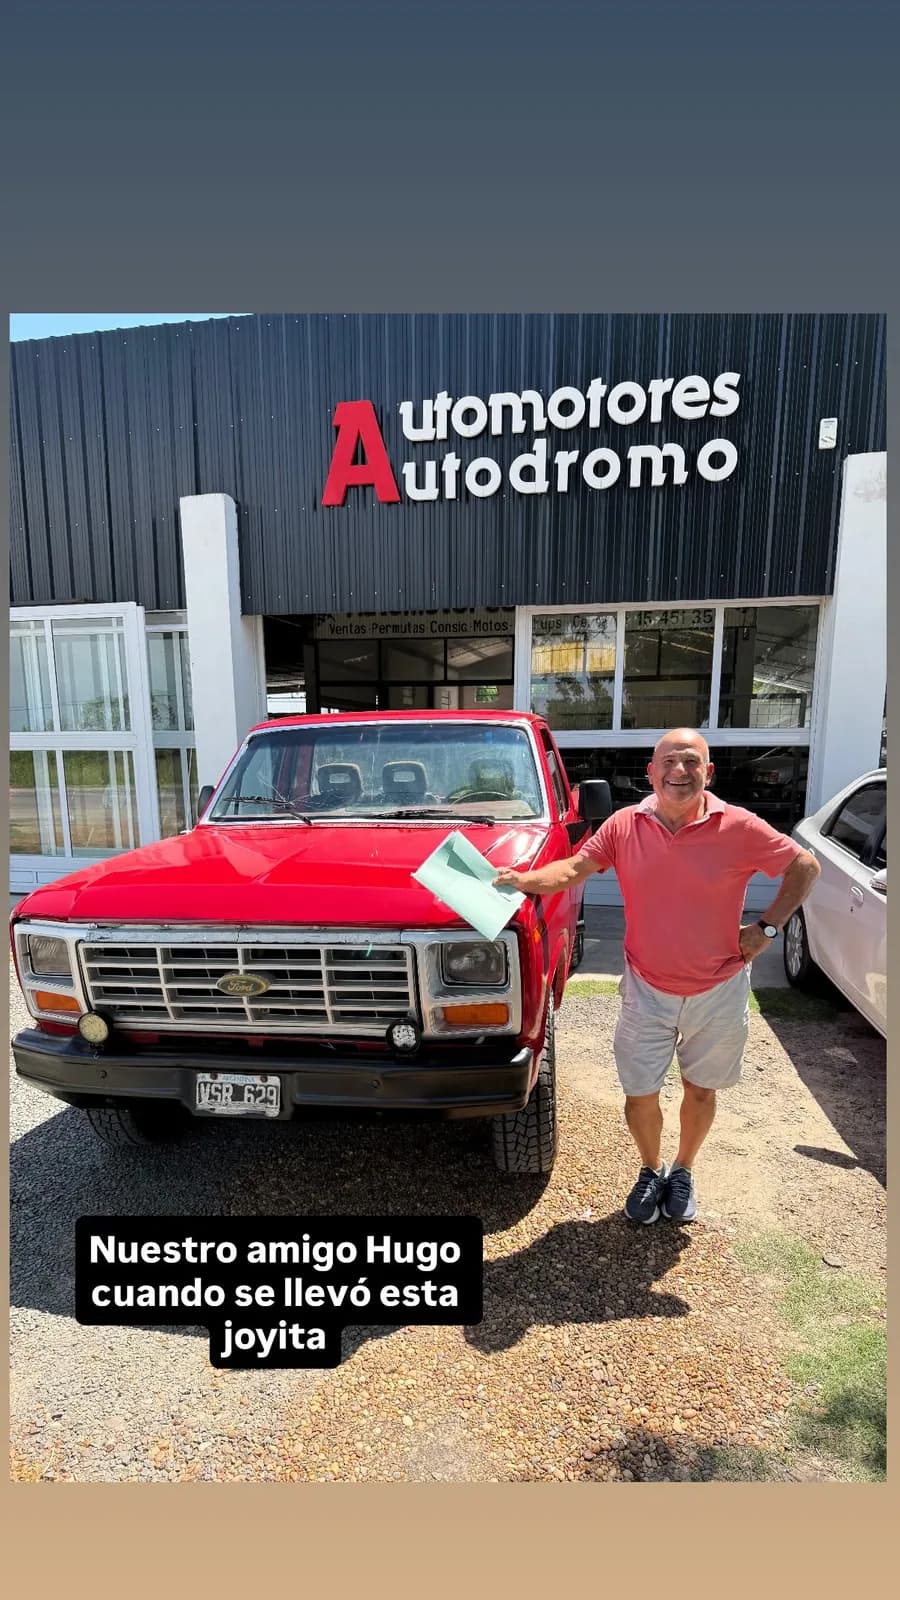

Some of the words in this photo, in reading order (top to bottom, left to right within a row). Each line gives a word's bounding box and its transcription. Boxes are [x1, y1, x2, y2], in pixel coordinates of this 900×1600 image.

[371, 622, 425, 634] Permutas
[227, 980, 254, 992] Ford
[244, 1084, 277, 1107] 629
